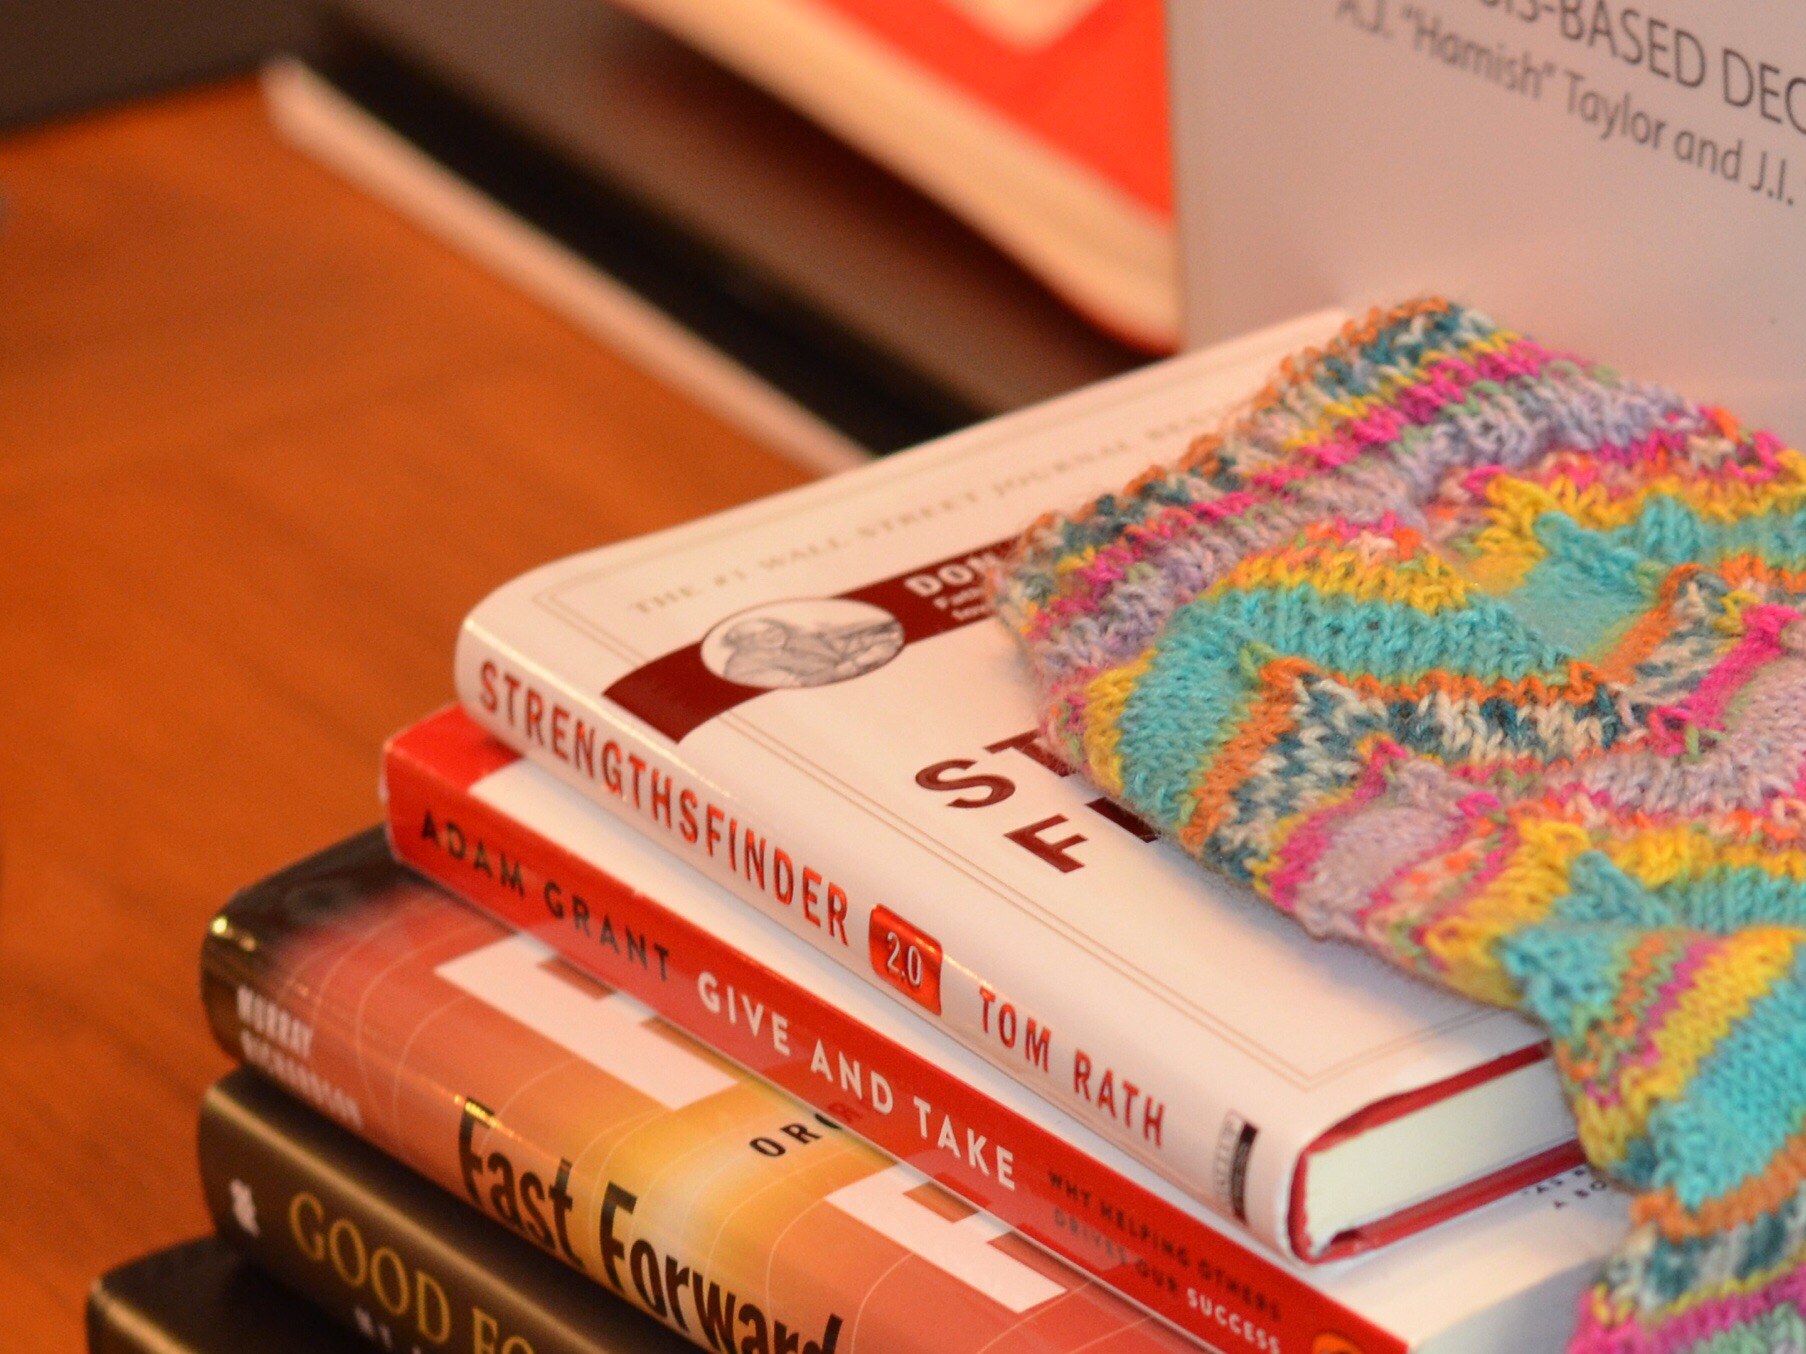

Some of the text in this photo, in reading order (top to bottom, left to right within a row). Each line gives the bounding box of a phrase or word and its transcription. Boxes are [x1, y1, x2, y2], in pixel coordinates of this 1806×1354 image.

[1563, 68, 1667, 150] Taylor
[1673, 129, 1743, 183] and
[1748, 150, 1795, 207] J.I.
[479, 660, 1166, 1148] STRENGTHSFINDER 2.0 TOM RATH
[420, 807, 1016, 1191] ADAM GRANT GIVE AND TAKE
[289, 1190, 452, 1346] GOOD
[458, 1096, 584, 1270] Fast
